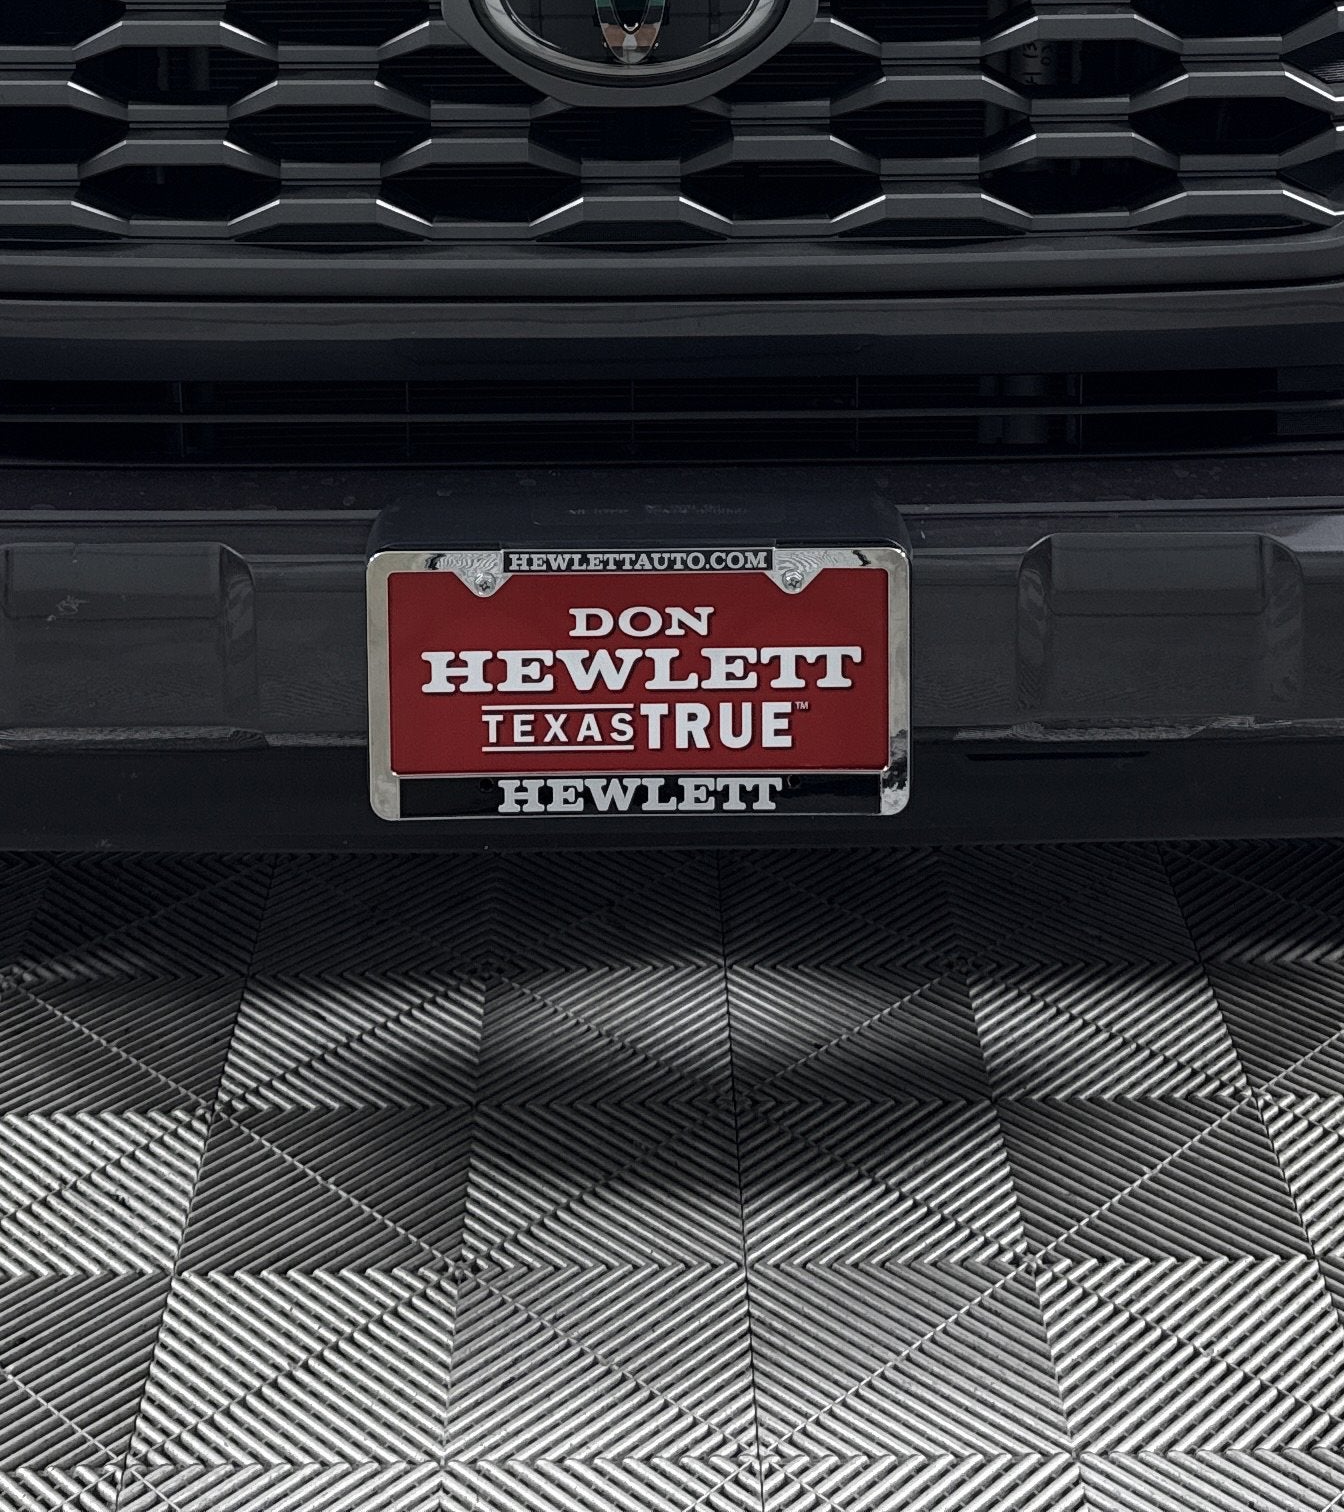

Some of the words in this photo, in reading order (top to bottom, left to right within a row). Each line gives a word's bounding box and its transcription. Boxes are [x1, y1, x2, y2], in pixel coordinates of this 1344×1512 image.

[508, 551, 768, 572] HEWLETTAUTO.COM
[568, 606, 715, 637] DON
[420, 645, 862, 693] HEWLETT
[497, 775, 783, 813] HEWLETT
